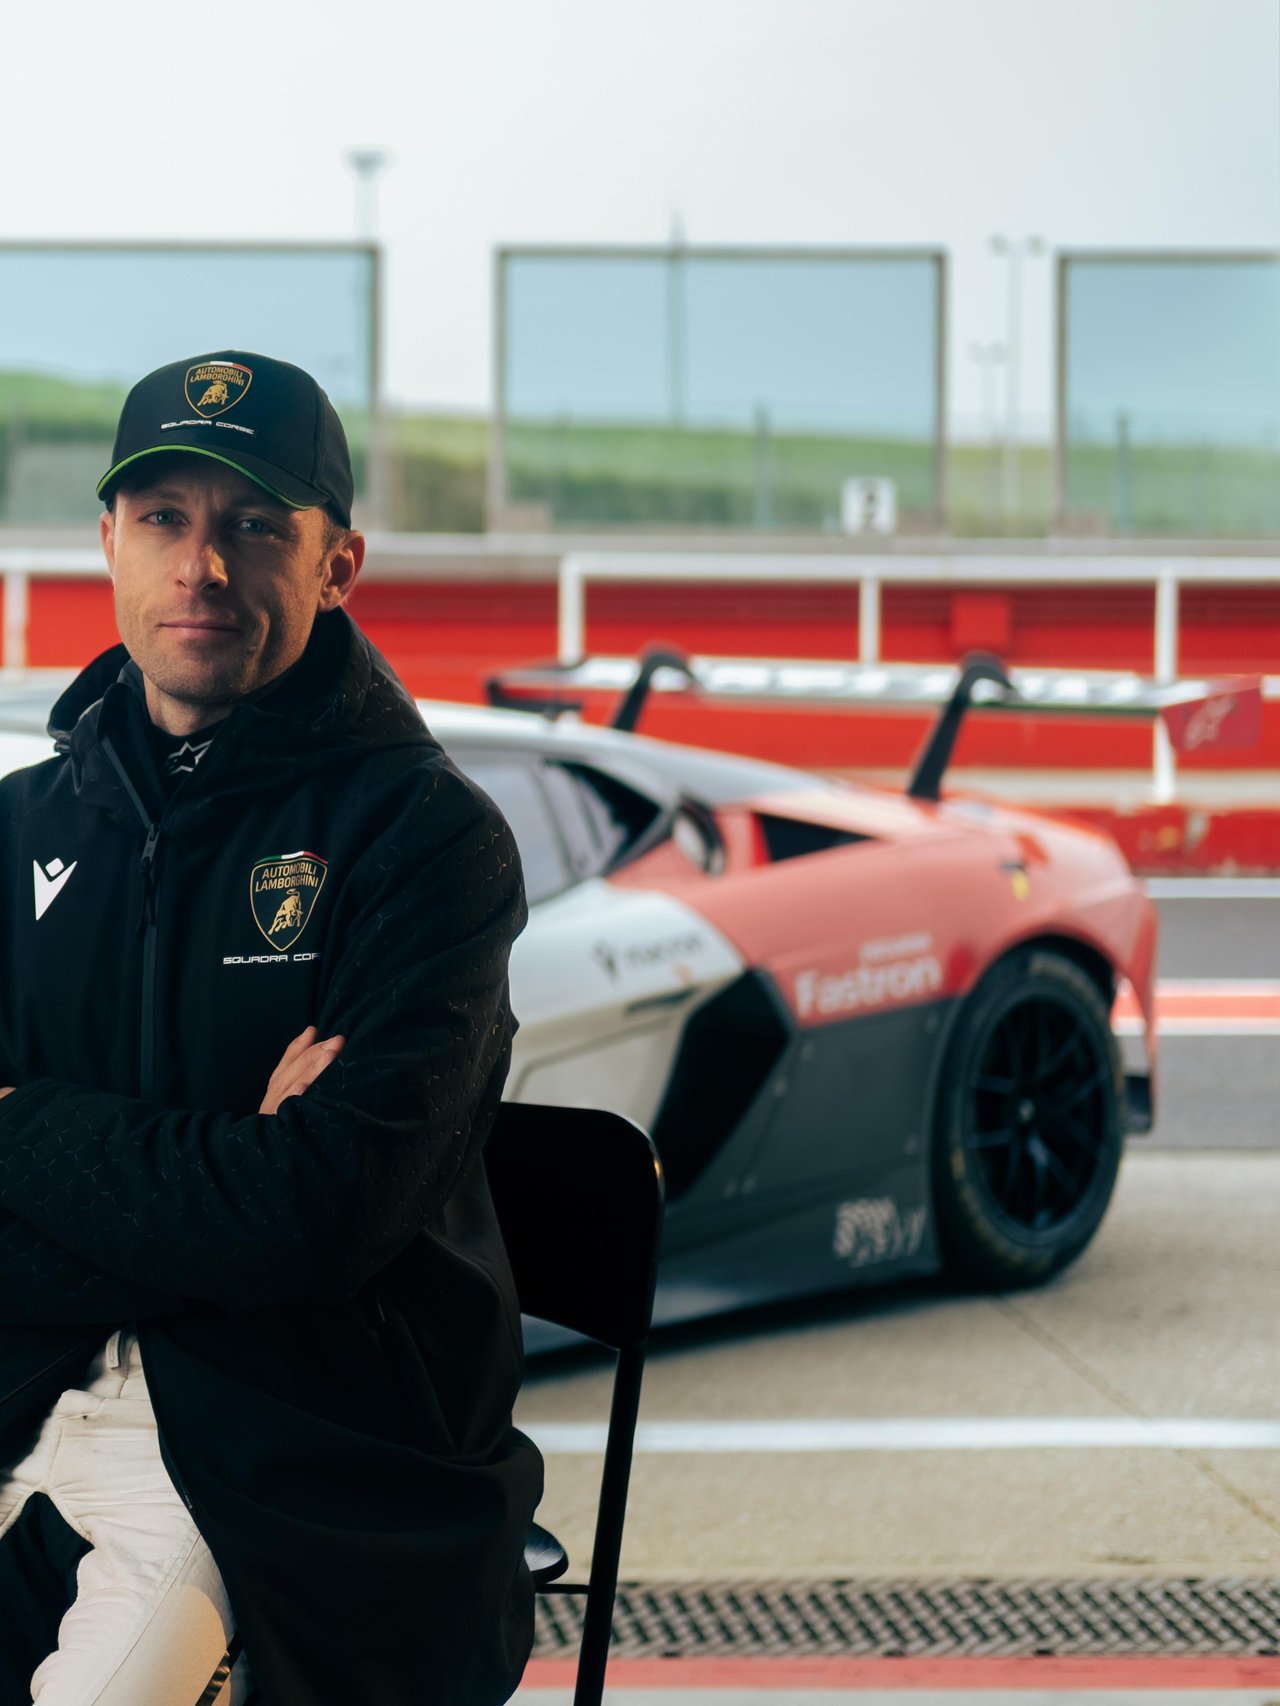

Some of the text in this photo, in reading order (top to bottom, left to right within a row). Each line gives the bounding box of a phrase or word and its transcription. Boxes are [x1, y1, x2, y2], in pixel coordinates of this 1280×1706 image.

[196, 366, 243, 378] AUTOMOBILI
[190, 373, 244, 386] LAMBORGHINI
[161, 420, 254, 434] SQUADRA CORSE
[262, 862, 317, 880] AUTOMOBILI
[255, 874, 318, 892] LAMBORGHINI
[223, 952, 320, 965] SQUADRA COR
[795, 956, 942, 1020] Fastron
